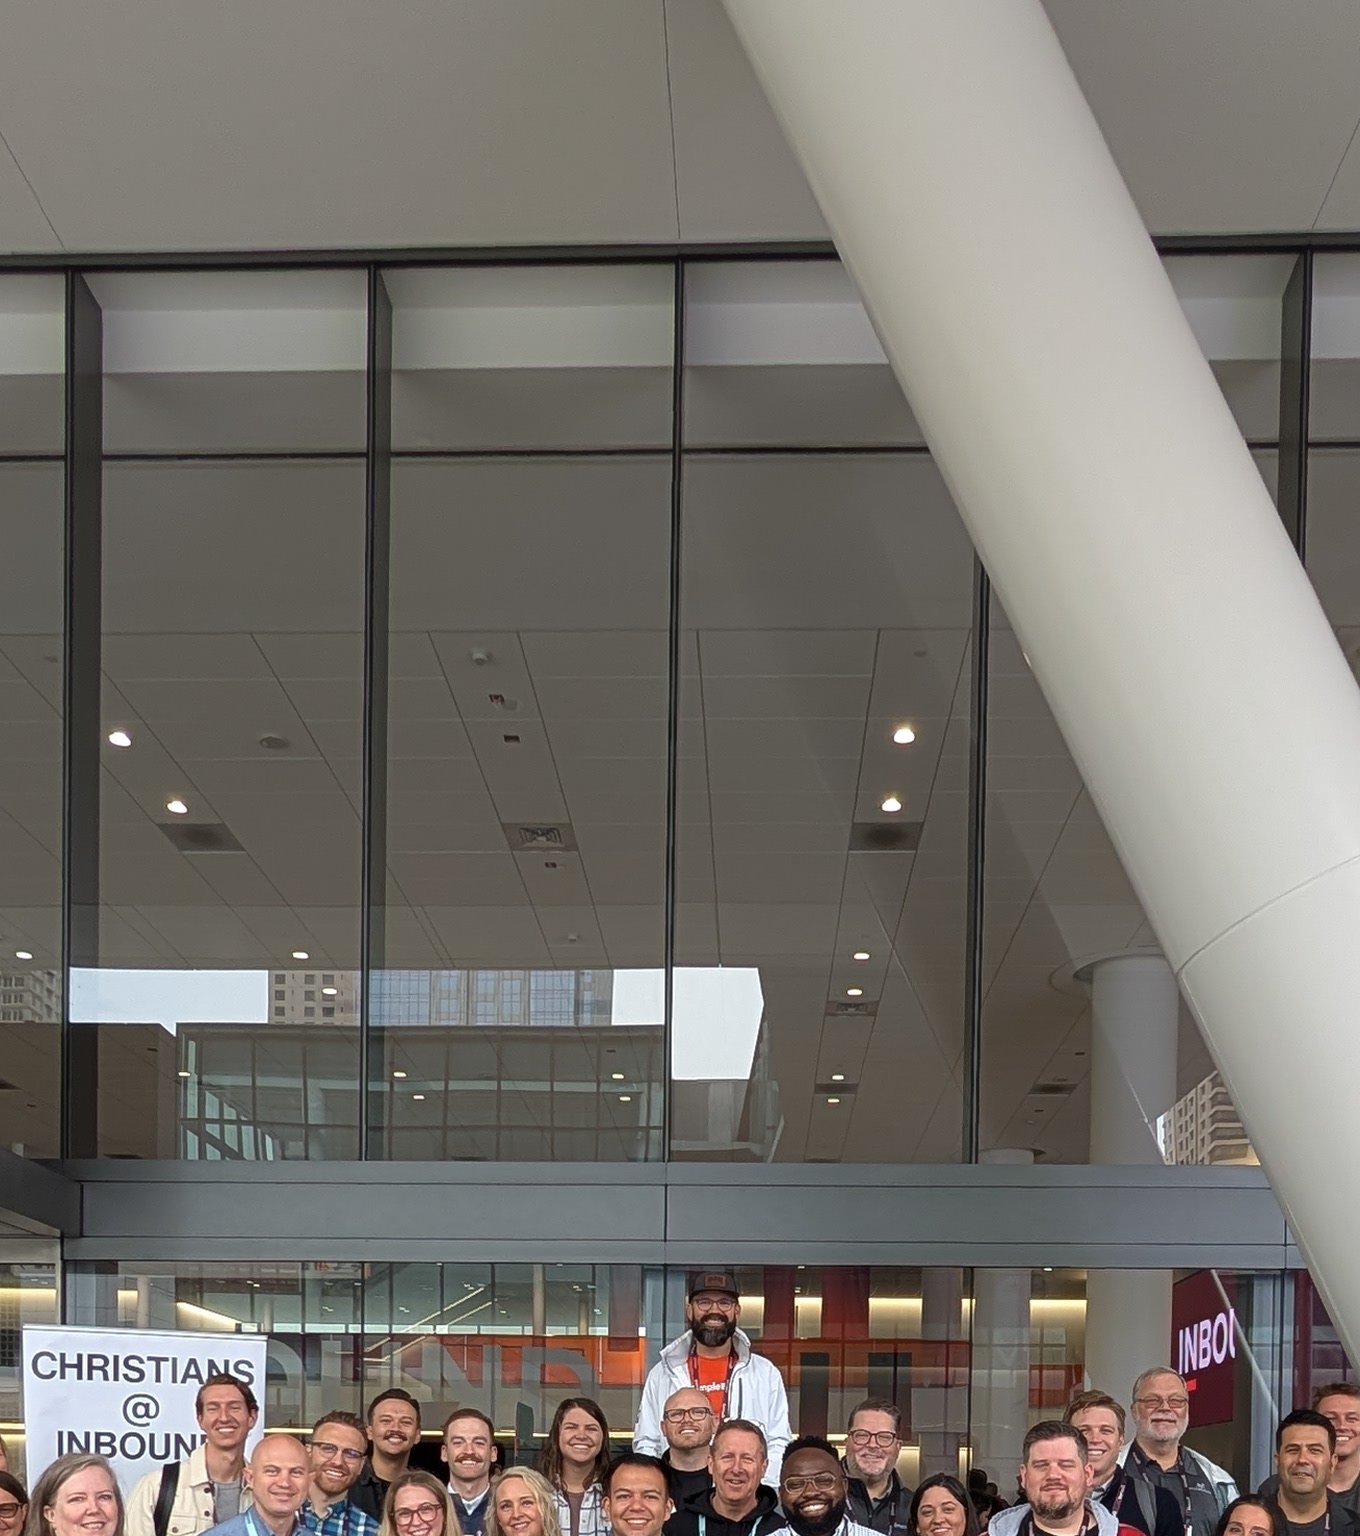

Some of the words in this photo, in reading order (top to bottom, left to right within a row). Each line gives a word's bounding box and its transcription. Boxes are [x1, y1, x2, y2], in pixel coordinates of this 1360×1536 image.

[1178, 1307, 1237, 1376] INBO
[31, 1350, 255, 1386] CHRISTIANS
[122, 1393, 160, 1427] @
[57, 1430, 208, 1460] INBOUN
